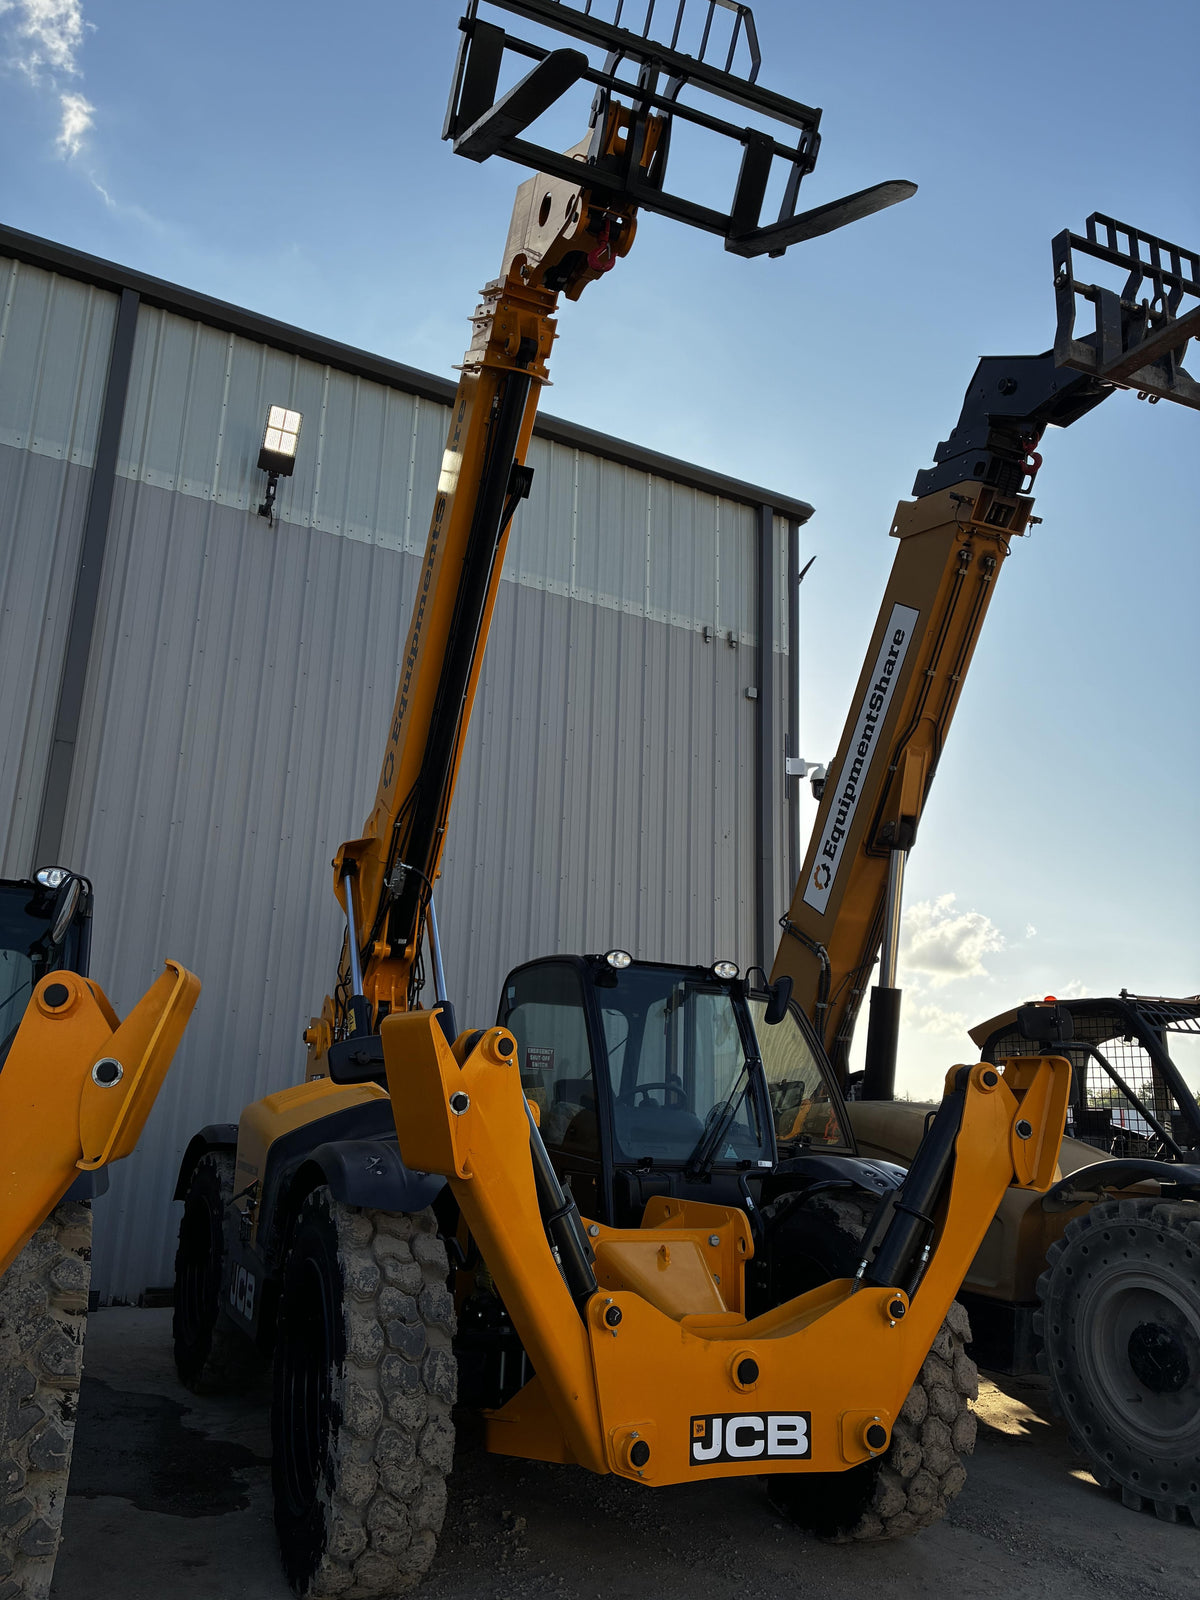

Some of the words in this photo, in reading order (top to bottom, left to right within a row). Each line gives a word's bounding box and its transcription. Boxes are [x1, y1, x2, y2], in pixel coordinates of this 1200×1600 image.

[391, 399, 466, 746] EquipmentSre
[823, 629, 905, 861] EquipmentShare
[229, 1263, 256, 1321] JCB
[693, 1416, 808, 1460] JCB
